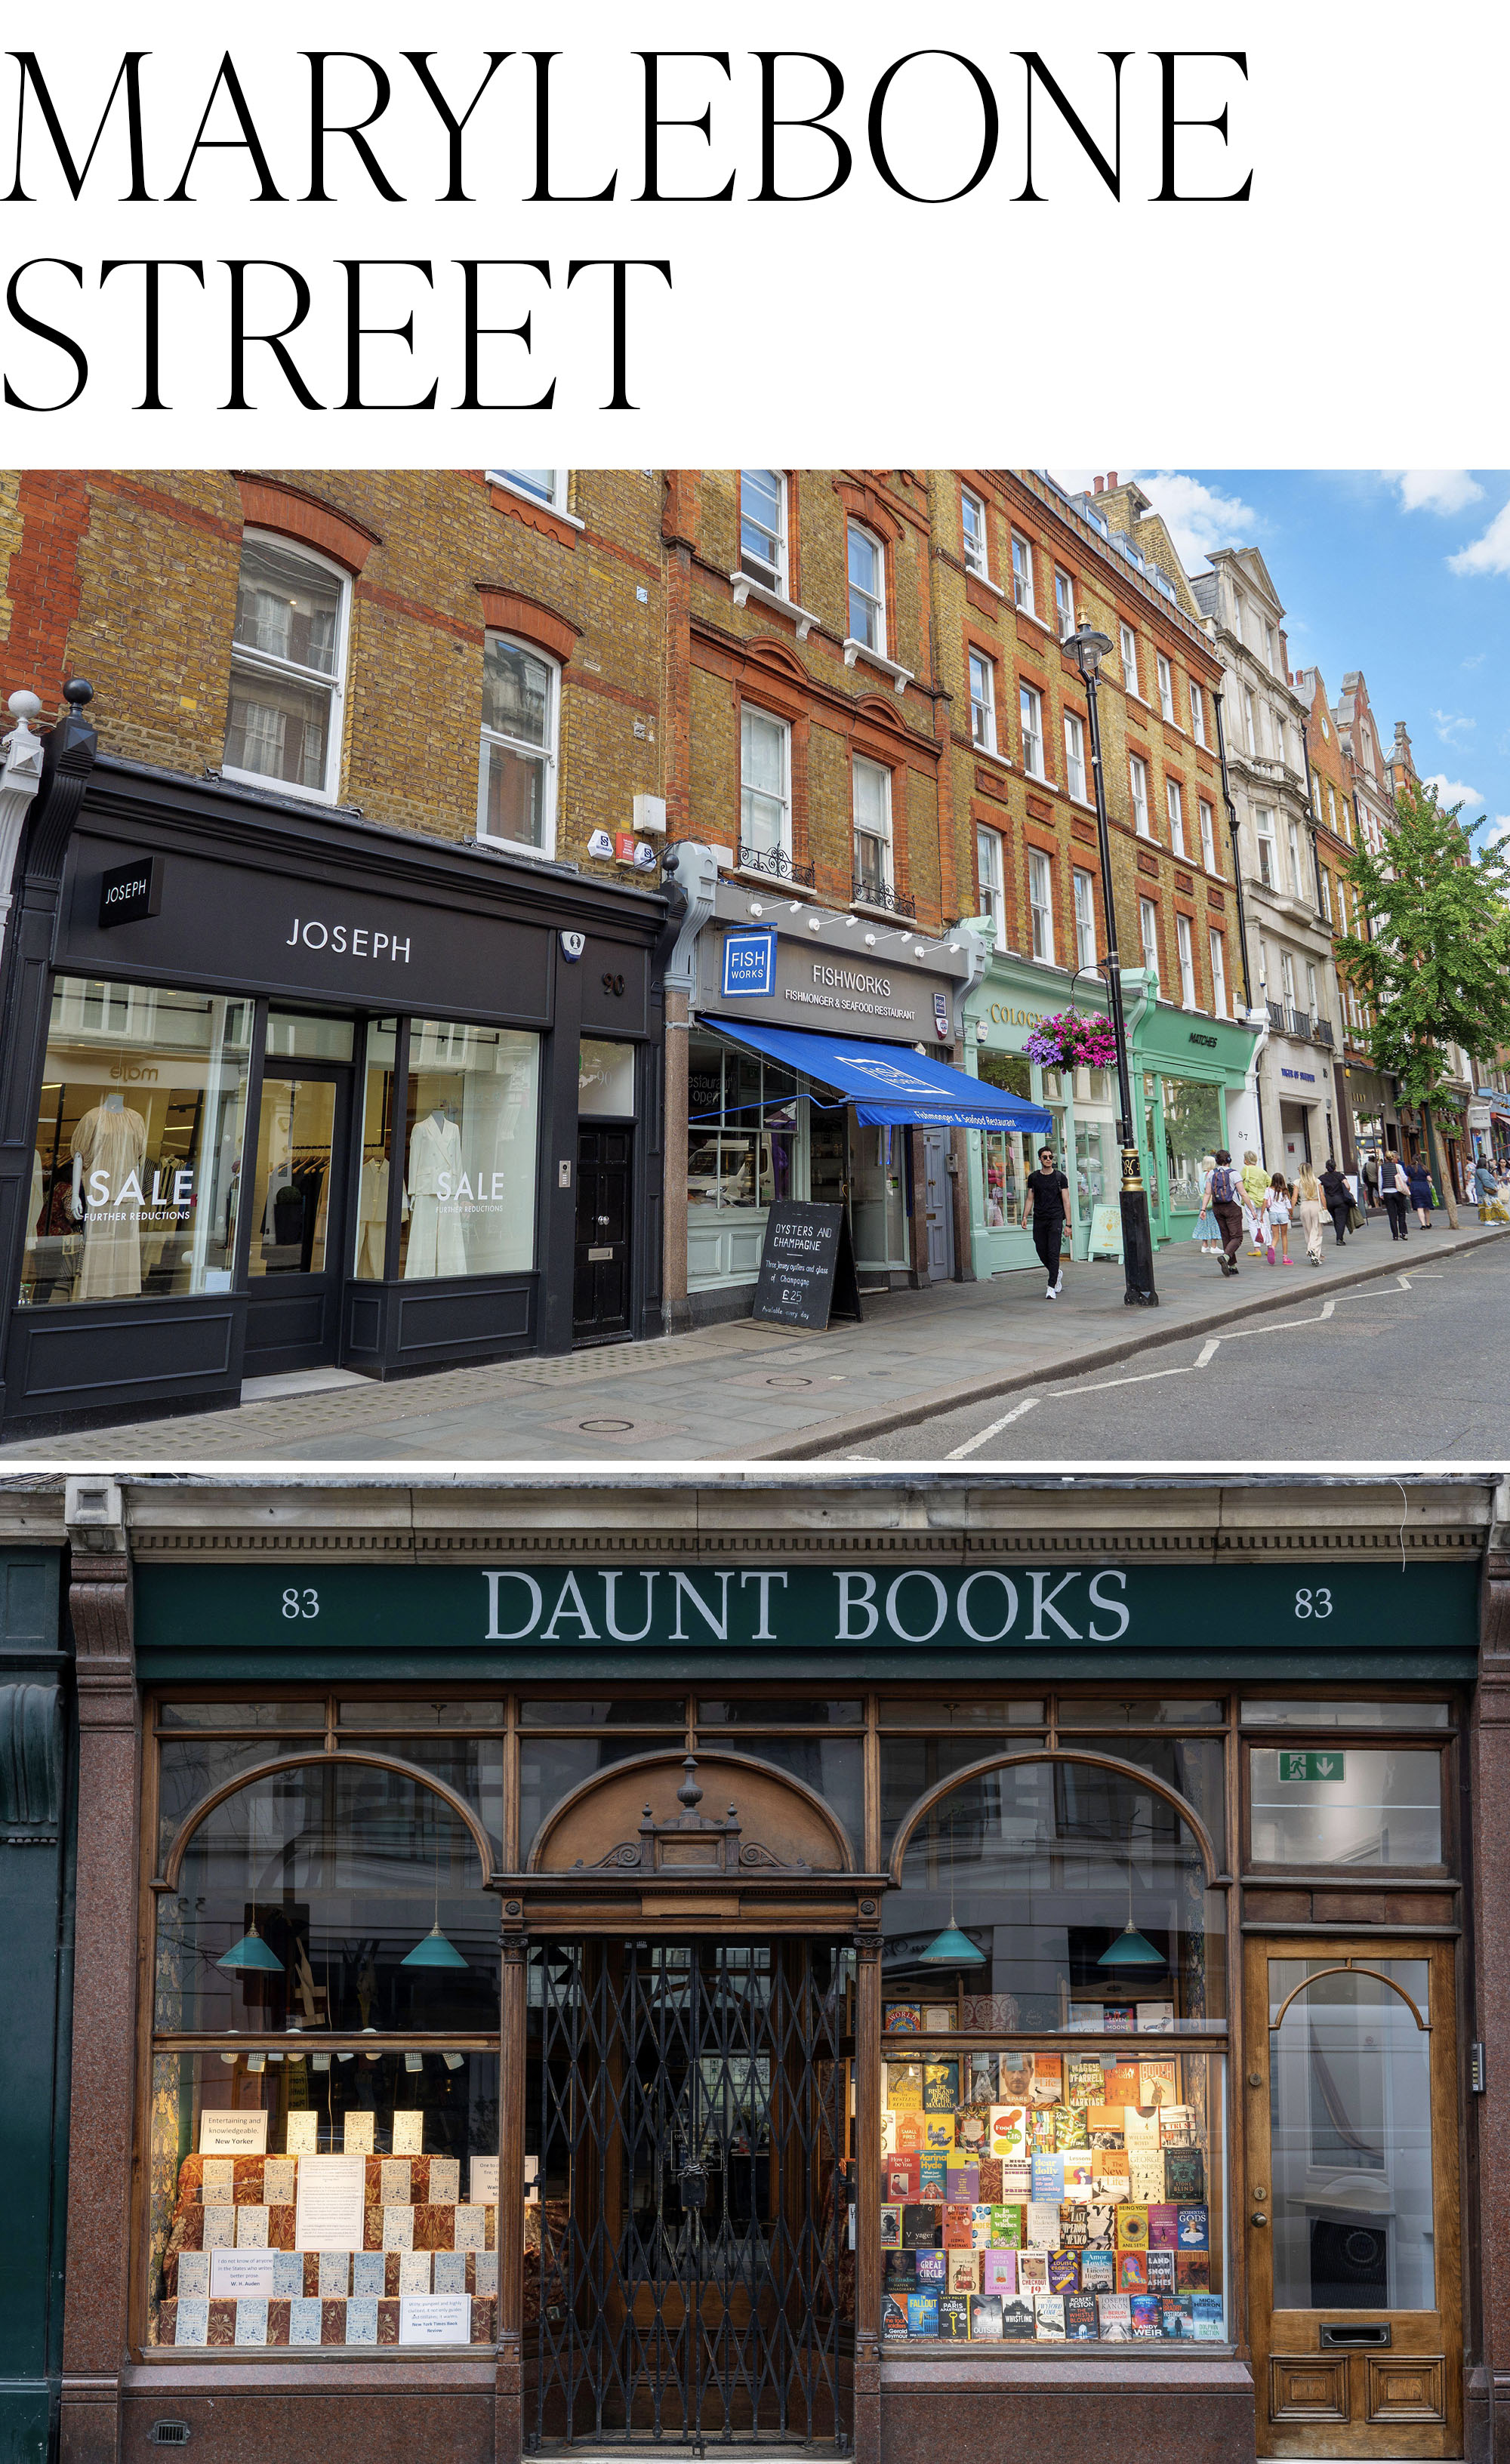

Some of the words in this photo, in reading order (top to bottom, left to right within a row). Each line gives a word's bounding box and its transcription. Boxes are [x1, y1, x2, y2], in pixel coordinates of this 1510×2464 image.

[106, 879, 146, 904] JOSEPH
[286, 919, 411, 963] JOSEPH
[731, 950, 765, 967] FISH
[731, 969, 763, 979] WORKS
[812, 965, 891, 996] FISHWORKS
[603, 973, 624, 996] 90
[784, 989, 834, 1008] FISHMONGER
[835, 998, 840, 1009] &
[841, 999, 874, 1014] SEAFOOD
[874, 1005, 915, 1021] RESTAURANT
[991, 1003, 1044, 1028] COLOGN
[1188, 1033, 1218, 1048] MATCHES
[914, 1110, 953, 1123] Fishmonger
[954, 1113, 961, 1123] &
[962, 1114, 986, 1125] Seafood
[986, 1116, 1017, 1127] Restaurant
[1238, 1132, 1248, 1140] 87
[87, 1169, 193, 1206] SALE
[436, 1171, 504, 1201] SALE
[85, 1212, 126, 1221] FURTHER
[130, 1212, 190, 1220] REDUCTIONS
[775, 1224, 814, 1237] OYSTERS
[817, 1227, 832, 1238] AND
[774, 1237, 821, 1251] CHAMPAGNE
[766, 1260, 776, 1268] Three
[776, 1261, 789, 1272] Jersey
[790, 1263, 805, 1272] oysters
[815, 1266, 828, 1274] glass
[771, 1274, 776, 1283] of
[781, 1274, 809, 1287] Champagne
[762, 1305, 783, 1315] Available
[801, 1311, 809, 1320] day
[282, 1587, 320, 1619] 83
[482, 1570, 787, 1643] DAUNT
[833, 1569, 1131, 1643] BOOKS
[1295, 1587, 1333, 1620] 83
[889, 2011, 917, 2022] WORLD
[1142, 2065, 1172, 2081] BOOTH
[1040, 2079, 1056, 2087] Life
[921, 2161, 942, 2170] Hyde
[1035, 2158, 1057, 2167] dear
[1035, 2167, 1059, 2176] dolly
[1102, 2167, 1123, 2176] New
[1107, 2177, 1123, 2185] Life
[1071, 2212, 1087, 2222] LAST
[1065, 2235, 1086, 2245] MEXICO
[920, 2261, 942, 2269] GREAT
[920, 2269, 942, 2278] CIRCLE
[910, 2299, 938, 2308] FALLOUT
